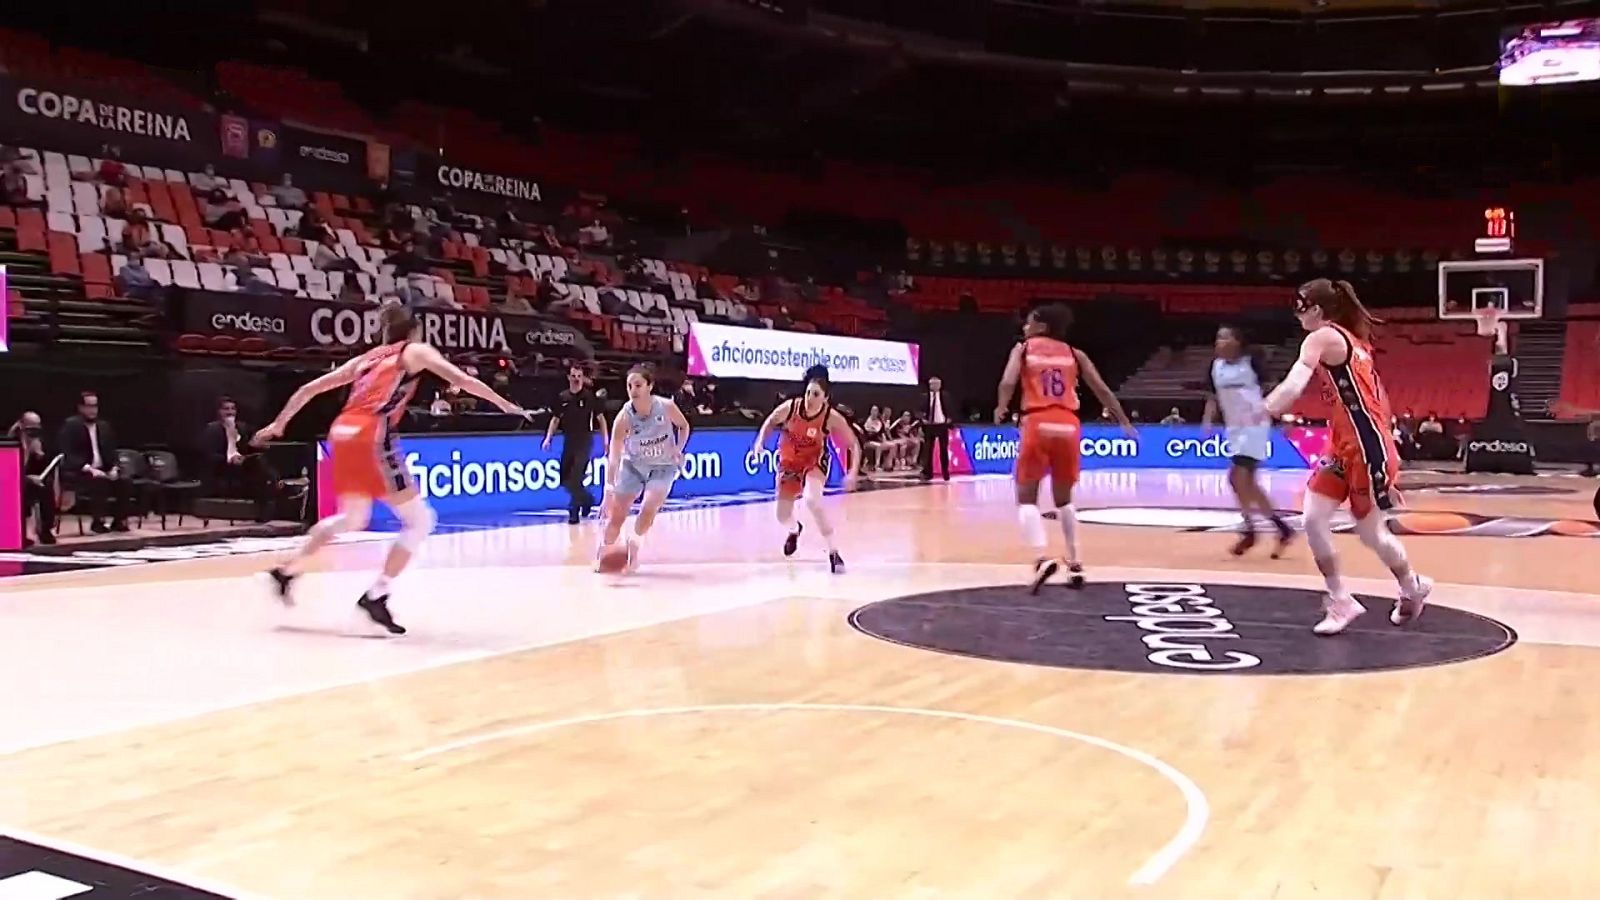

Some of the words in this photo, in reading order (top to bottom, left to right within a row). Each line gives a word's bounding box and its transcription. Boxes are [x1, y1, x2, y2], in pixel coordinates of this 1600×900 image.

[17, 88, 98, 126] COPA
[100, 104, 114, 117] DE
[100, 117, 116, 130] LA
[116, 107, 191, 141] REINA
[437, 165, 484, 190] COPA
[495, 176, 541, 201] REINA
[211, 312, 285, 334] endesa
[310, 307, 382, 346] COP
[424, 312, 508, 351] REINA
[525, 328, 575, 345] endesa
[1469, 439, 1528, 453] endesa
[1104, 583, 1262, 671] endesa
